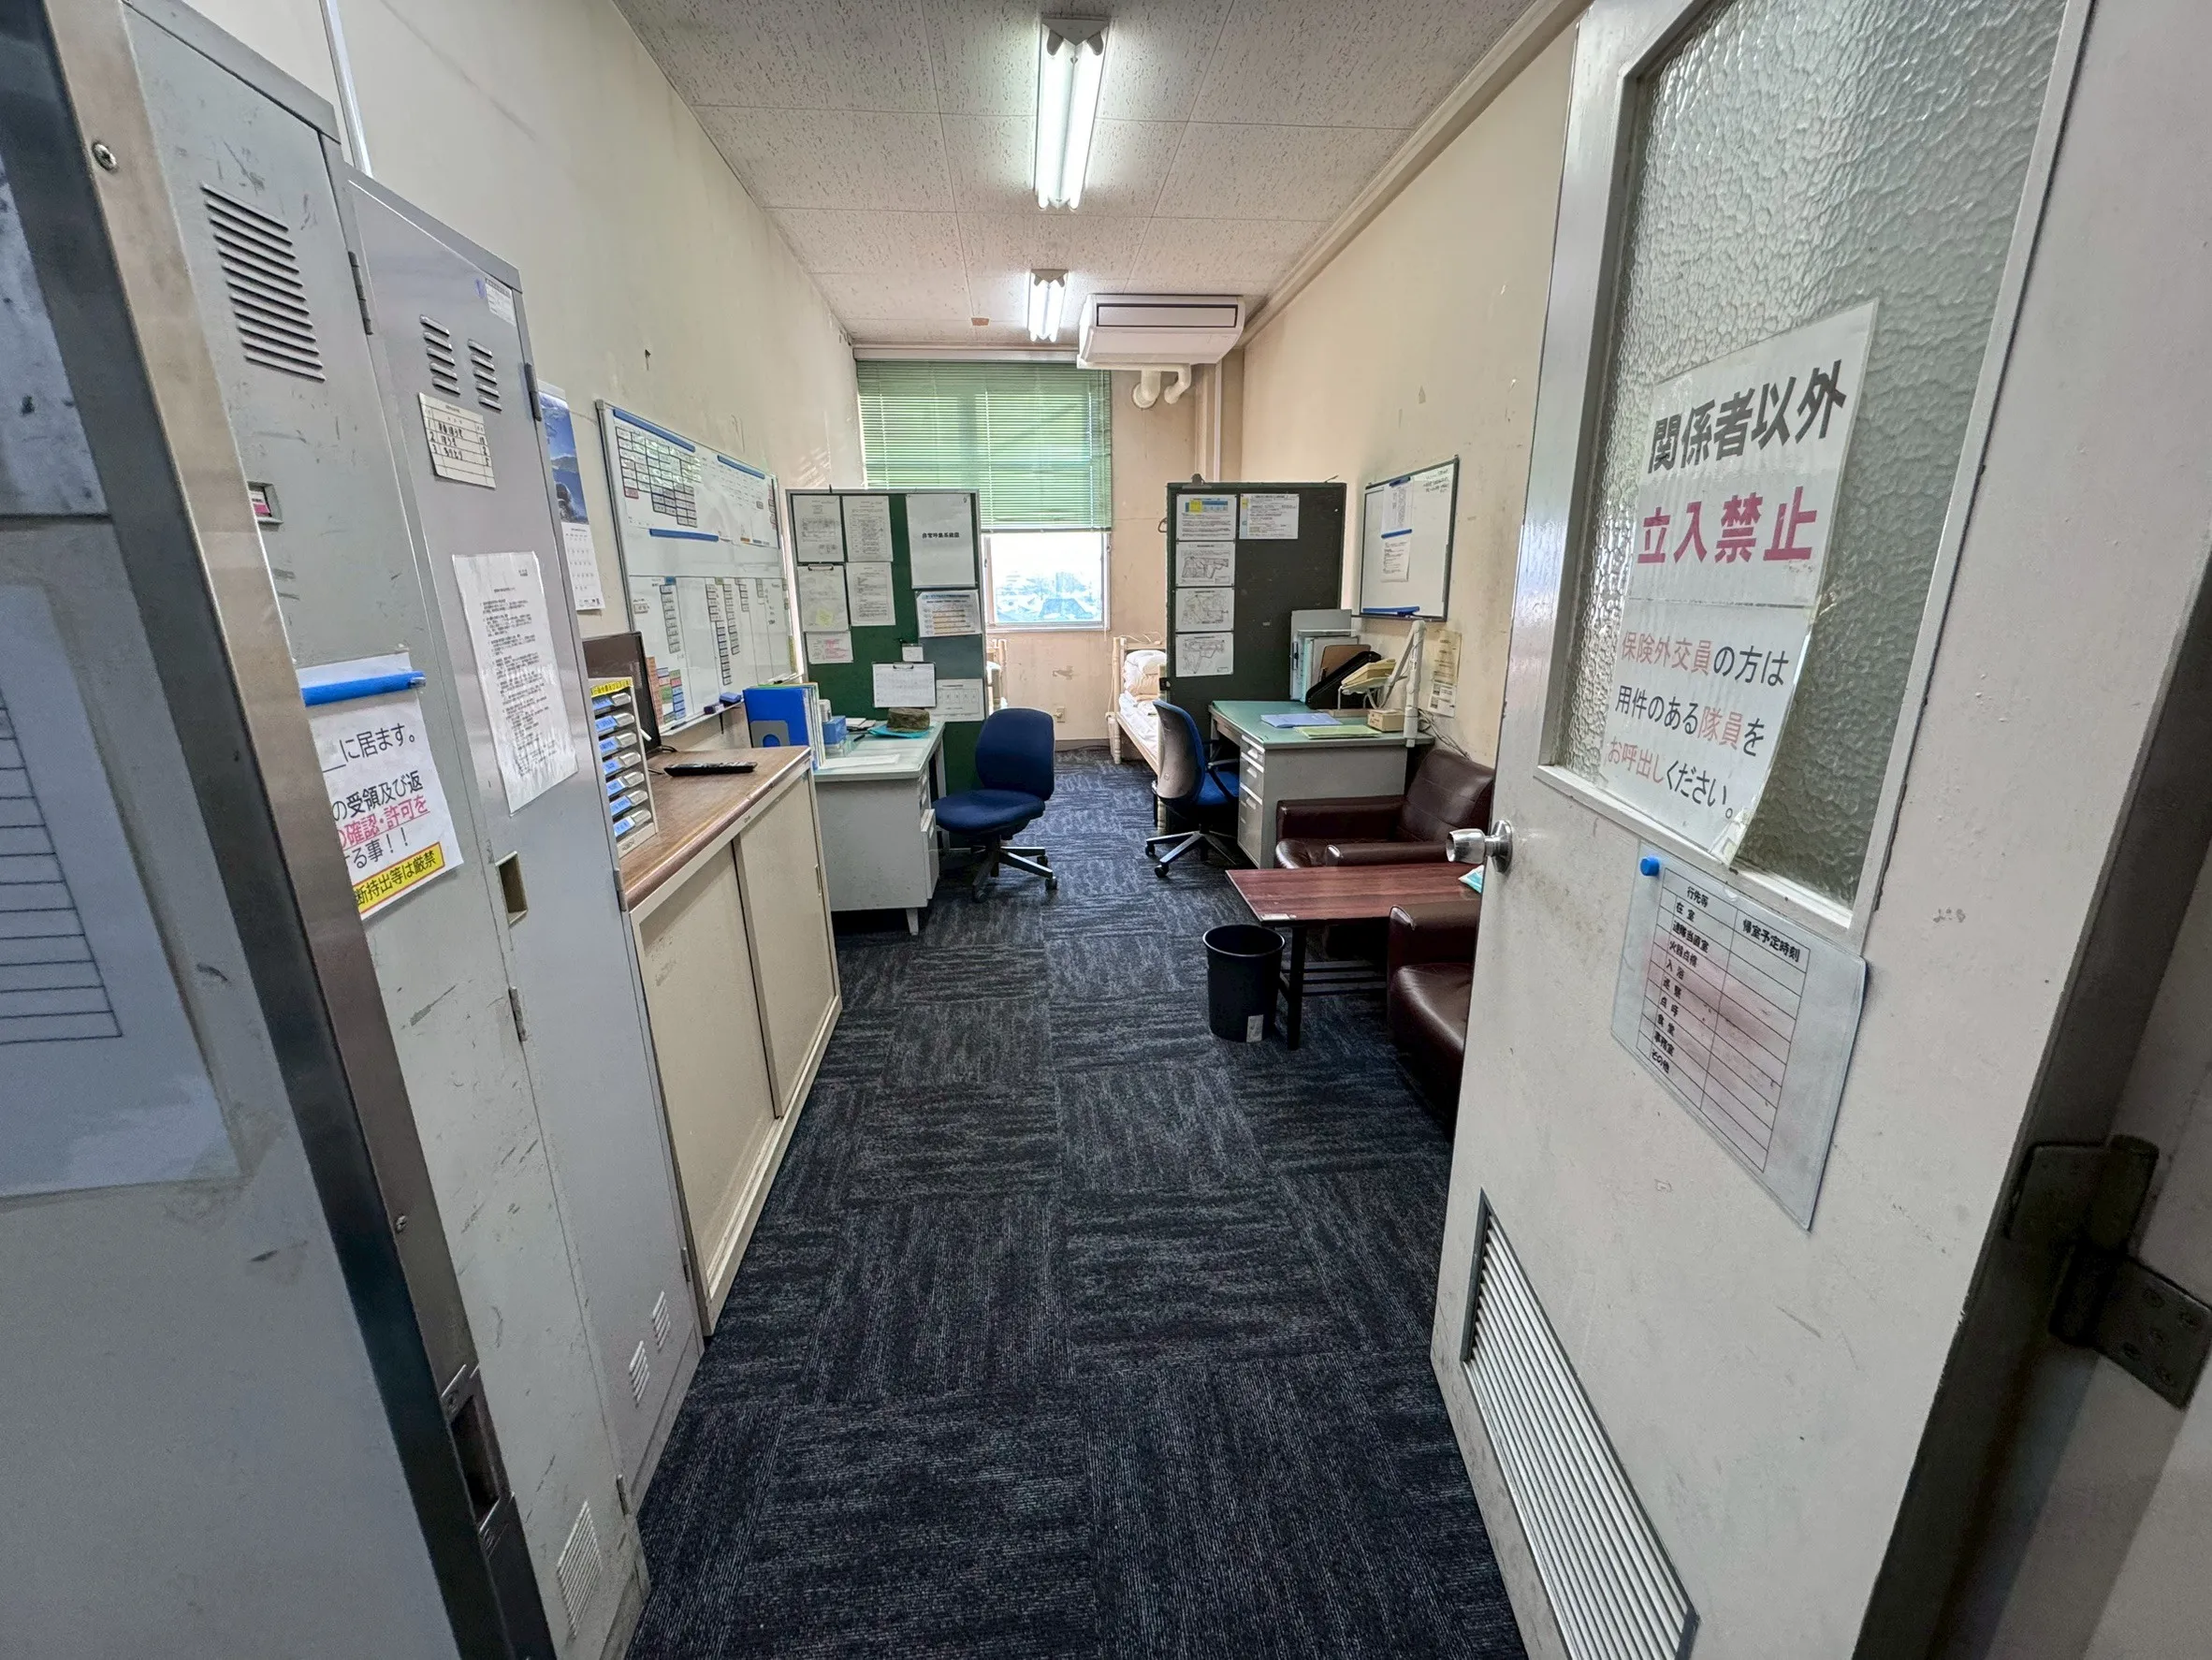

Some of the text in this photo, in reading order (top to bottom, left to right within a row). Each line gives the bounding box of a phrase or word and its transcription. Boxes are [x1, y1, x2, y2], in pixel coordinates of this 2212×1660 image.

[1647, 360, 1848, 473] 関係者以外
[1637, 486, 1818, 564] 立入禁止
[1621, 629, 1789, 687] 保険外交員の方は
[339, 722, 415, 764] に居ます。
[1614, 685, 1766, 757] 用件のある隊員を
[332, 770, 424, 822] の受領及び返
[1607, 738, 1735, 820] お呼出しください。
[343, 827, 409, 869] る事！！
[1742, 919, 1801, 963] 帰室予定時刻
